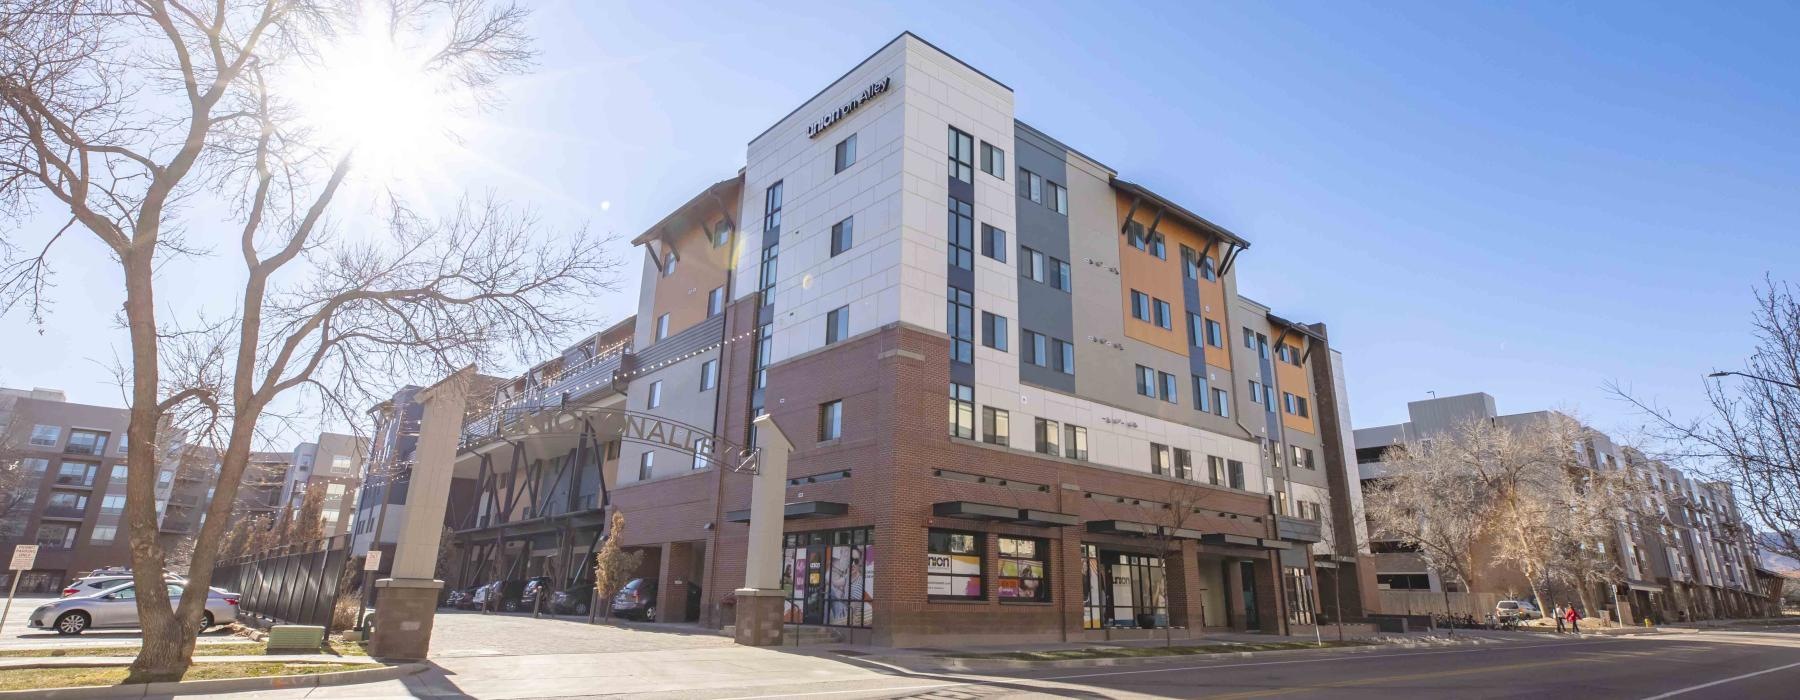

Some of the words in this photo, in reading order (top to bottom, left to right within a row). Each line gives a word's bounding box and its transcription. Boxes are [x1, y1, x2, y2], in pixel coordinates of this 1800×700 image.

[843, 100, 858, 114] on
[860, 77, 891, 104] Alley
[928, 556, 950, 567] nion
